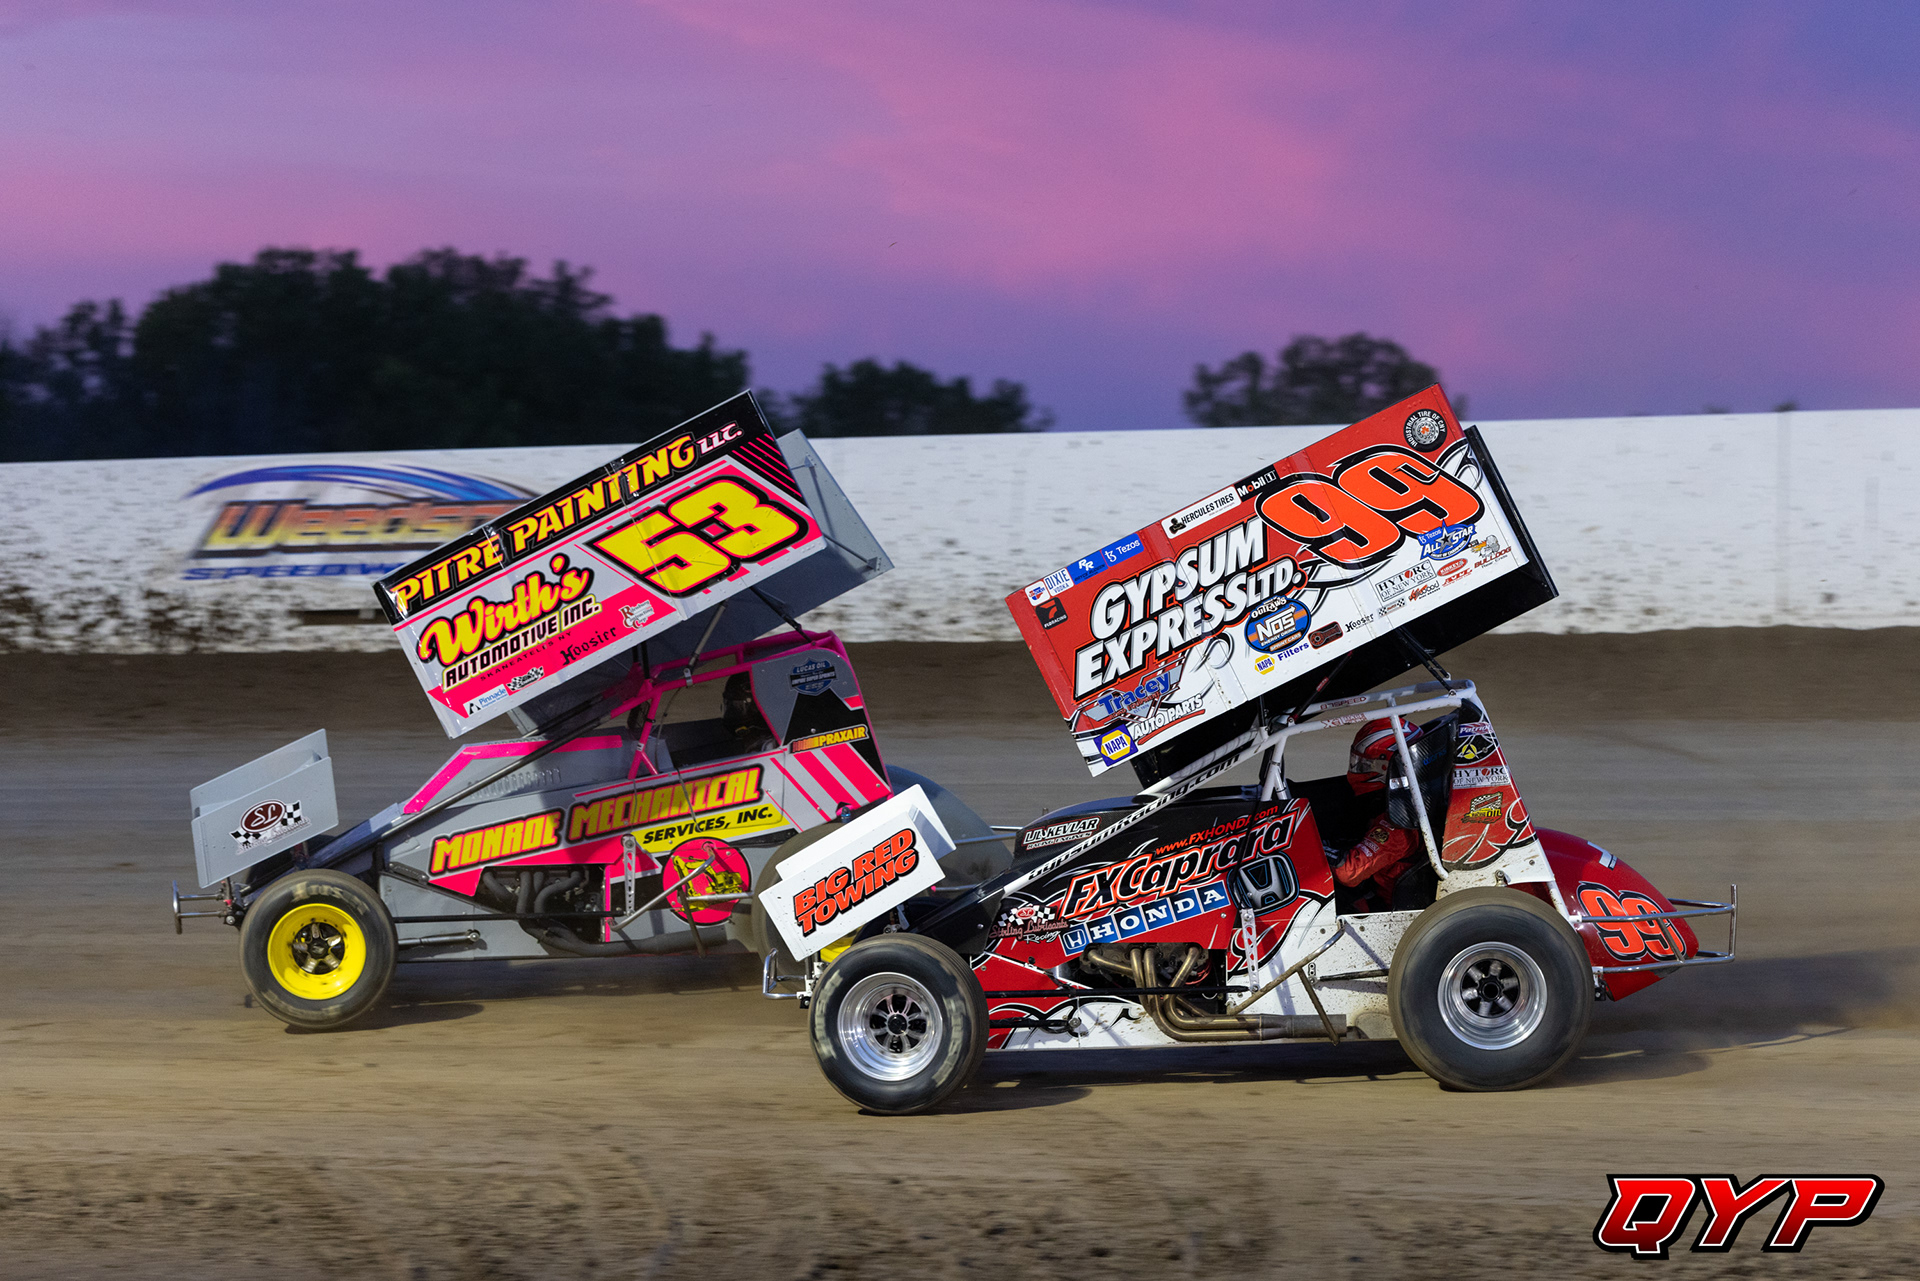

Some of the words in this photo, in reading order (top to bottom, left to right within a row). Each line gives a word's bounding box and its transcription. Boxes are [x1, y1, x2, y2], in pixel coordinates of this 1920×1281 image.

[1438, 420, 1446, 432] CNY
[1237, 476, 1266, 497] Mobil
[1181, 503, 1215, 525] HERCULES
[1215, 493, 1235, 510] TIRES
[1258, 449, 1482, 566] 99
[390, 534, 504, 613] PITRE
[506, 435, 696, 552] PAINTING
[590, 477, 804, 595] 53
[1425, 529, 1441, 539] Tezos
[1116, 539, 1140, 554] Tezos
[1423, 542, 1441, 556] ALL
[1452, 525, 1473, 544] STAR
[1078, 559, 1094, 571] RR
[1474, 546, 1511, 569] BULLDOG
[1045, 569, 1070, 590] DIXIE
[1054, 583, 1070, 594] VODKA
[1090, 516, 1264, 640] GYPSUM
[1381, 588, 1393, 598] OF
[1392, 581, 1410, 592] NEW
[1411, 571, 1434, 584] YORK
[419, 555, 592, 666] Wirth's
[1255, 604, 1296, 642] NOS
[444, 612, 560, 691] AUTOMOTIVE
[561, 595, 602, 630] INC.
[558, 631, 571, 641] NY
[1075, 572, 1247, 698] EXPRESS
[1246, 558, 1303, 608] LTD.
[1261, 635, 1281, 647] ENERGY
[1281, 627, 1296, 638] DRINK
[560, 627, 616, 666] Hoosier
[1257, 658, 1273, 672] NAPA
[1277, 642, 1310, 661] Filters
[796, 663, 815, 673] LUCAS
[816, 661, 826, 669] OIL
[478, 688, 506, 705] Pinnacle
[1098, 671, 1170, 715] Tracey
[1132, 712, 1167, 740] AUTO
[1167, 694, 1203, 721] PARTS
[820, 727, 866, 746] PRAXAIR
[1105, 735, 1128, 756] NAPA
[1466, 776, 1484, 785] NEW
[1486, 774, 1509, 783] YORK
[251, 804, 278, 828] SL
[431, 811, 562, 874] MONROE
[568, 766, 763, 840] MECHANICAL
[643, 815, 730, 844] SERVICES,
[736, 806, 773, 824] INC.
[1045, 817, 1101, 839] KEVLAR
[1155, 805, 1279, 855] www.FXHONDA.com
[793, 867, 850, 917] BIG
[852, 828, 915, 881] RED
[797, 849, 918, 935] TOWING
[1024, 918, 1069, 934] Lubricants
[1091, 888, 1225, 940] HONDA
[1579, 884, 1685, 958] 99
[1023, 930, 1061, 944] Racing
